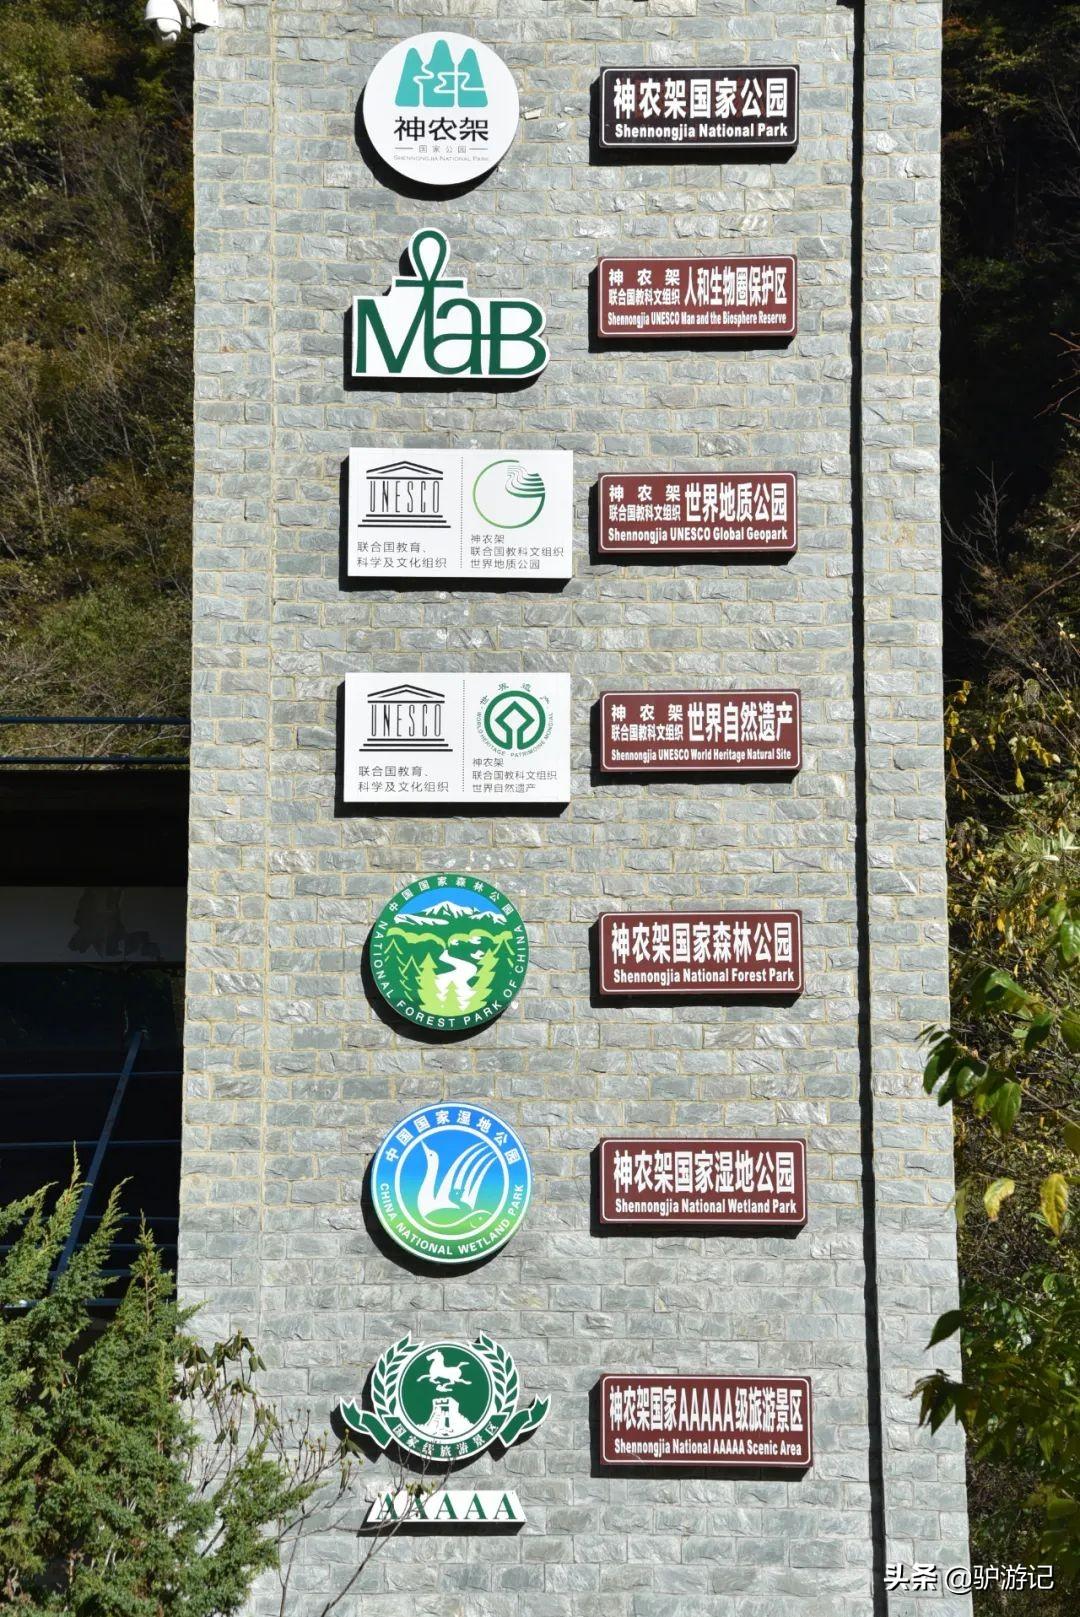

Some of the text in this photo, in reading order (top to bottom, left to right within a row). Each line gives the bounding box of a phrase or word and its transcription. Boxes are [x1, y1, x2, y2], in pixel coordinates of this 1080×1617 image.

[613, 77, 788, 119] 神农架国家公园
[394, 116, 489, 142] 神农架
[615, 122, 788, 141] Shennongjia National Park
[419, 145, 466, 153] 国家公园
[608, 268, 681, 286] 神农架
[684, 266, 787, 307] 人和生物圈保护区
[608, 288, 681, 306] 联合国教科文组织
[607, 311, 787, 329] Shennongjia UNESCO Man and the Biosphere Reserve
[370, 480, 440, 514] UNESCO
[608, 484, 681, 502] 神农架
[684, 482, 787, 523] 世界地质公园
[608, 503, 681, 522] 联合国教科文组织
[470, 534, 504, 544] 神农架
[608, 527, 788, 544] Shennongjia UNESCO Global Geopark
[470, 546, 564, 557] 联合国教科文组织
[357, 557, 447, 569] 科学及文化组织
[470, 559, 540, 570] 世界地质公园
[371, 703, 442, 737] UNESCO
[611, 704, 683, 722] 神农架
[687, 701, 793, 743] 世界自然遗产
[611, 723, 683, 742] 联合国教科文组织
[472, 757, 504, 767] 神农架
[611, 747, 792, 764] Shennongjia UNESCO World Heritage Natural Site
[472, 770, 557, 781] 联合国教科文组织
[358, 781, 449, 793] 科学及文化组织
[472, 783, 536, 793] 世界自然遗产
[388, 876, 514, 915] 中国国家森林公园
[611, 921, 793, 964] 神农架国家森林公园
[372, 920, 526, 1027] NATIONAL FOREST PARK OF CHINA
[613, 967, 794, 986] Shennongjia National Forest Park
[385, 1109, 522, 1165] 中国国家湿地公园
[613, 1149, 795, 1194] 神农架国家湿地公园
[615, 1198, 797, 1216] Shennongjia National Wetland Park
[380, 1183, 524, 1255] CHINA NATIONAL WETLAND PARK
[609, 1385, 803, 1433] 神农架国家AAAAA级旅游景区
[614, 1438, 802, 1457] Shennongjia National AAAAA Scenic Area
